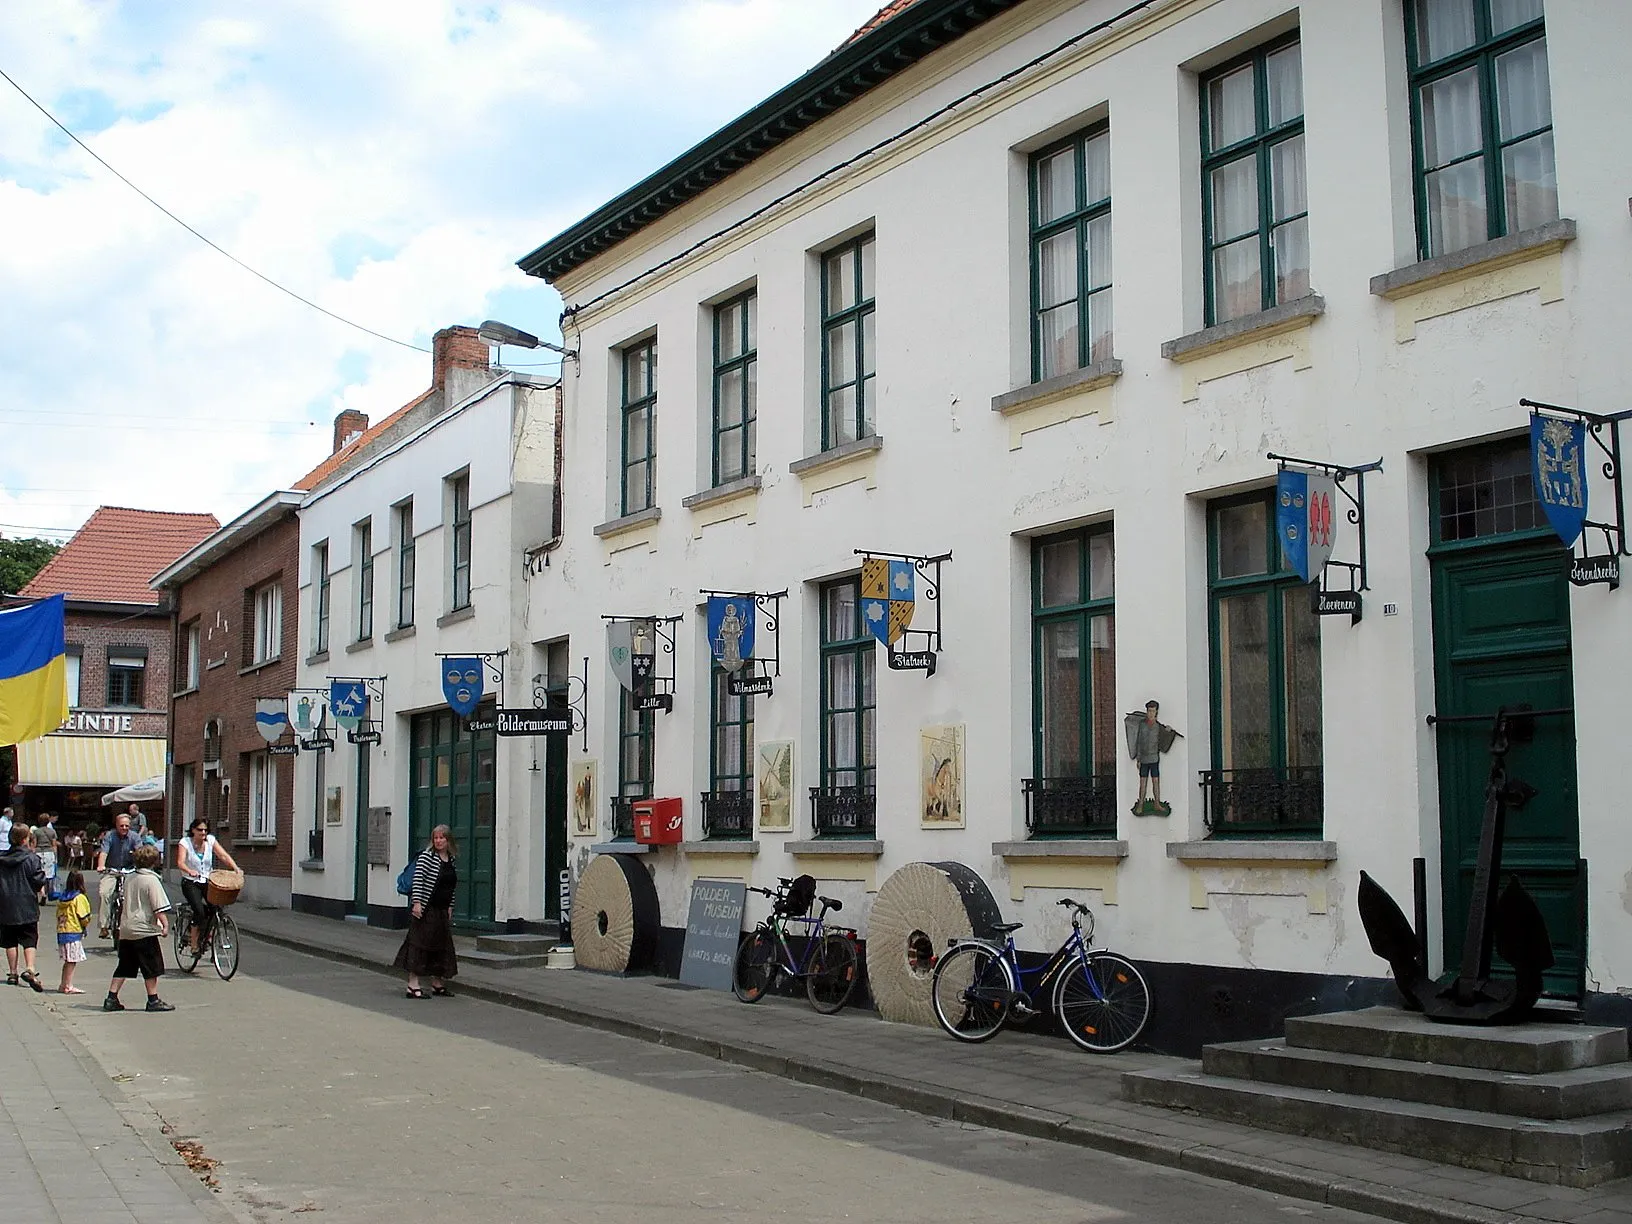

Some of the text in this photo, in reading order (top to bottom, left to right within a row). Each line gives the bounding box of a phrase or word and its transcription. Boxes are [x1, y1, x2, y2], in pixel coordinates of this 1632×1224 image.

[1571, 560, 1618, 580] Berendrecht
[1319, 595, 1356, 611] Hoevenen
[497, 713, 568, 731] Poldermuseum
[560, 869, 571, 924] OPEN
[704, 902, 742, 920] MUSEUM
